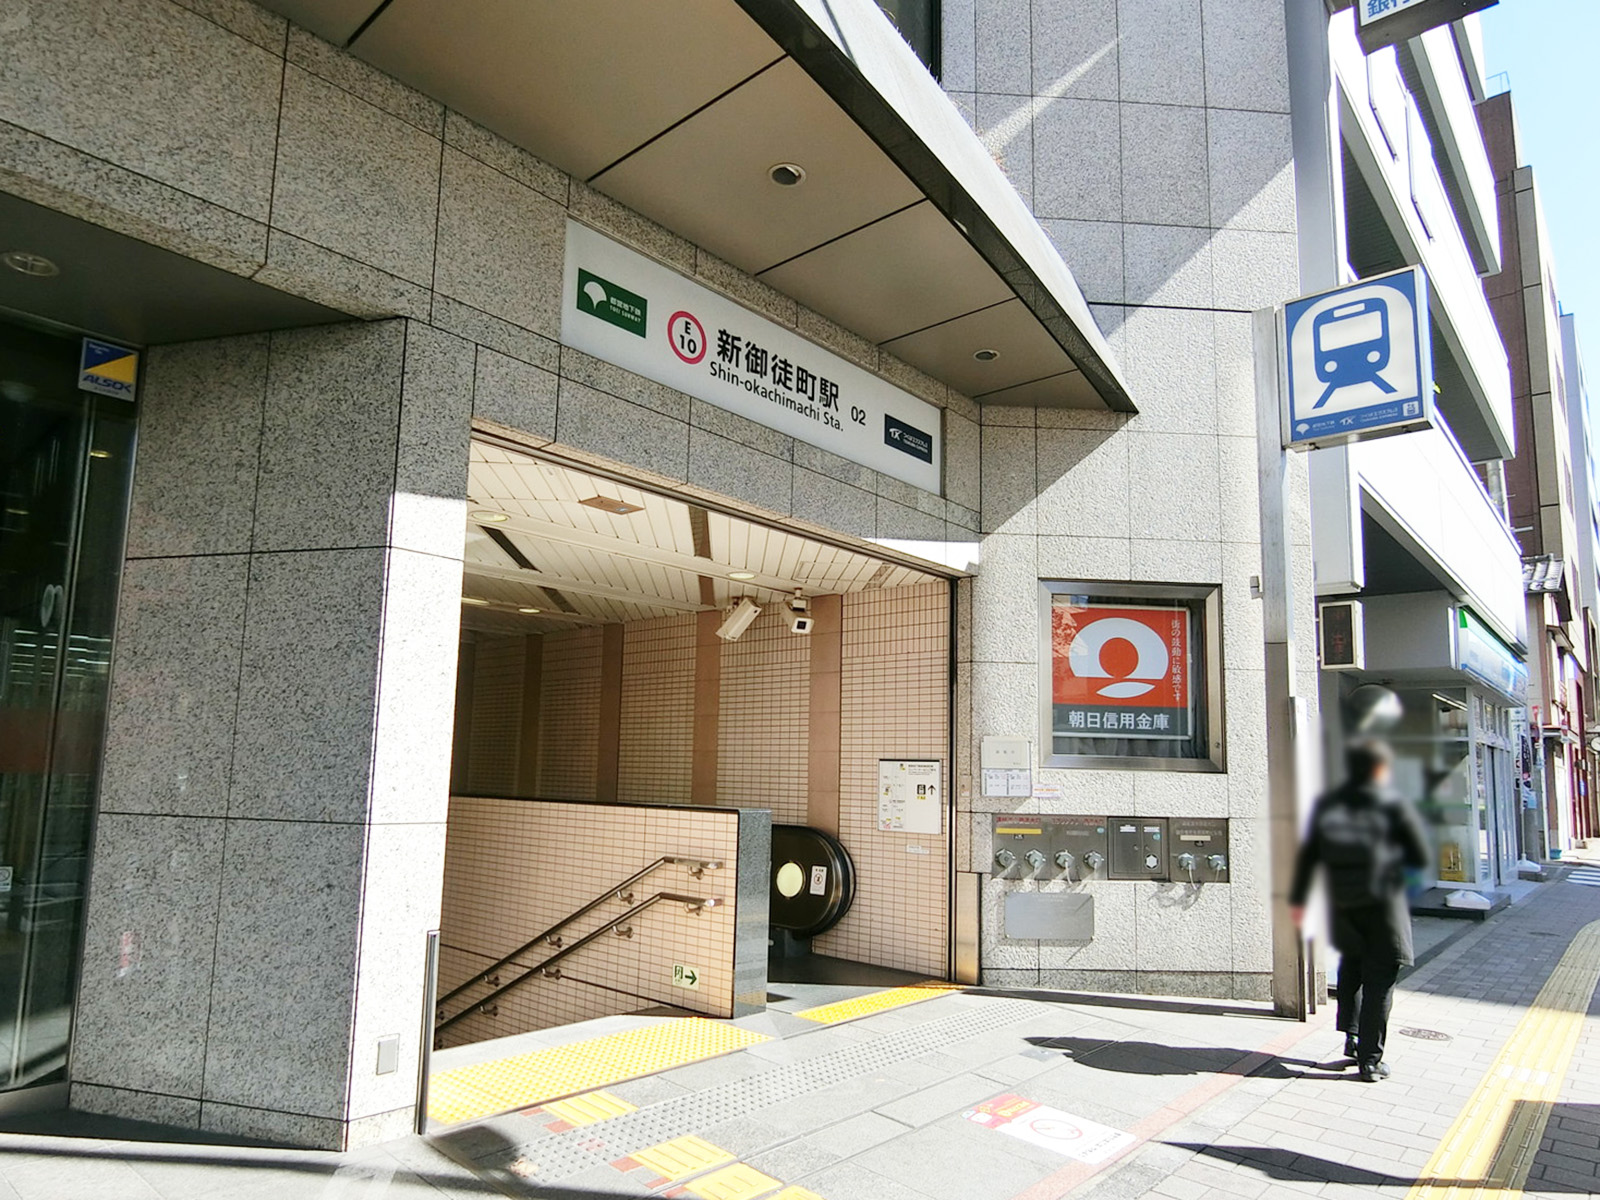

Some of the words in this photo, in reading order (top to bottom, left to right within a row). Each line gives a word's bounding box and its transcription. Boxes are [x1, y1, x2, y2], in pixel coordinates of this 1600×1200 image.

[685, 321, 691, 335] E
[680, 334, 697, 354] 10
[717, 328, 839, 412] 新御徒町駅
[82, 374, 132, 394] ALSOK
[710, 361, 820, 421] Shin-okachimachi
[823, 411, 844, 432] Sta.
[851, 405, 867, 426] 02
[1068, 710, 1170, 731] 朝日信用金庫
